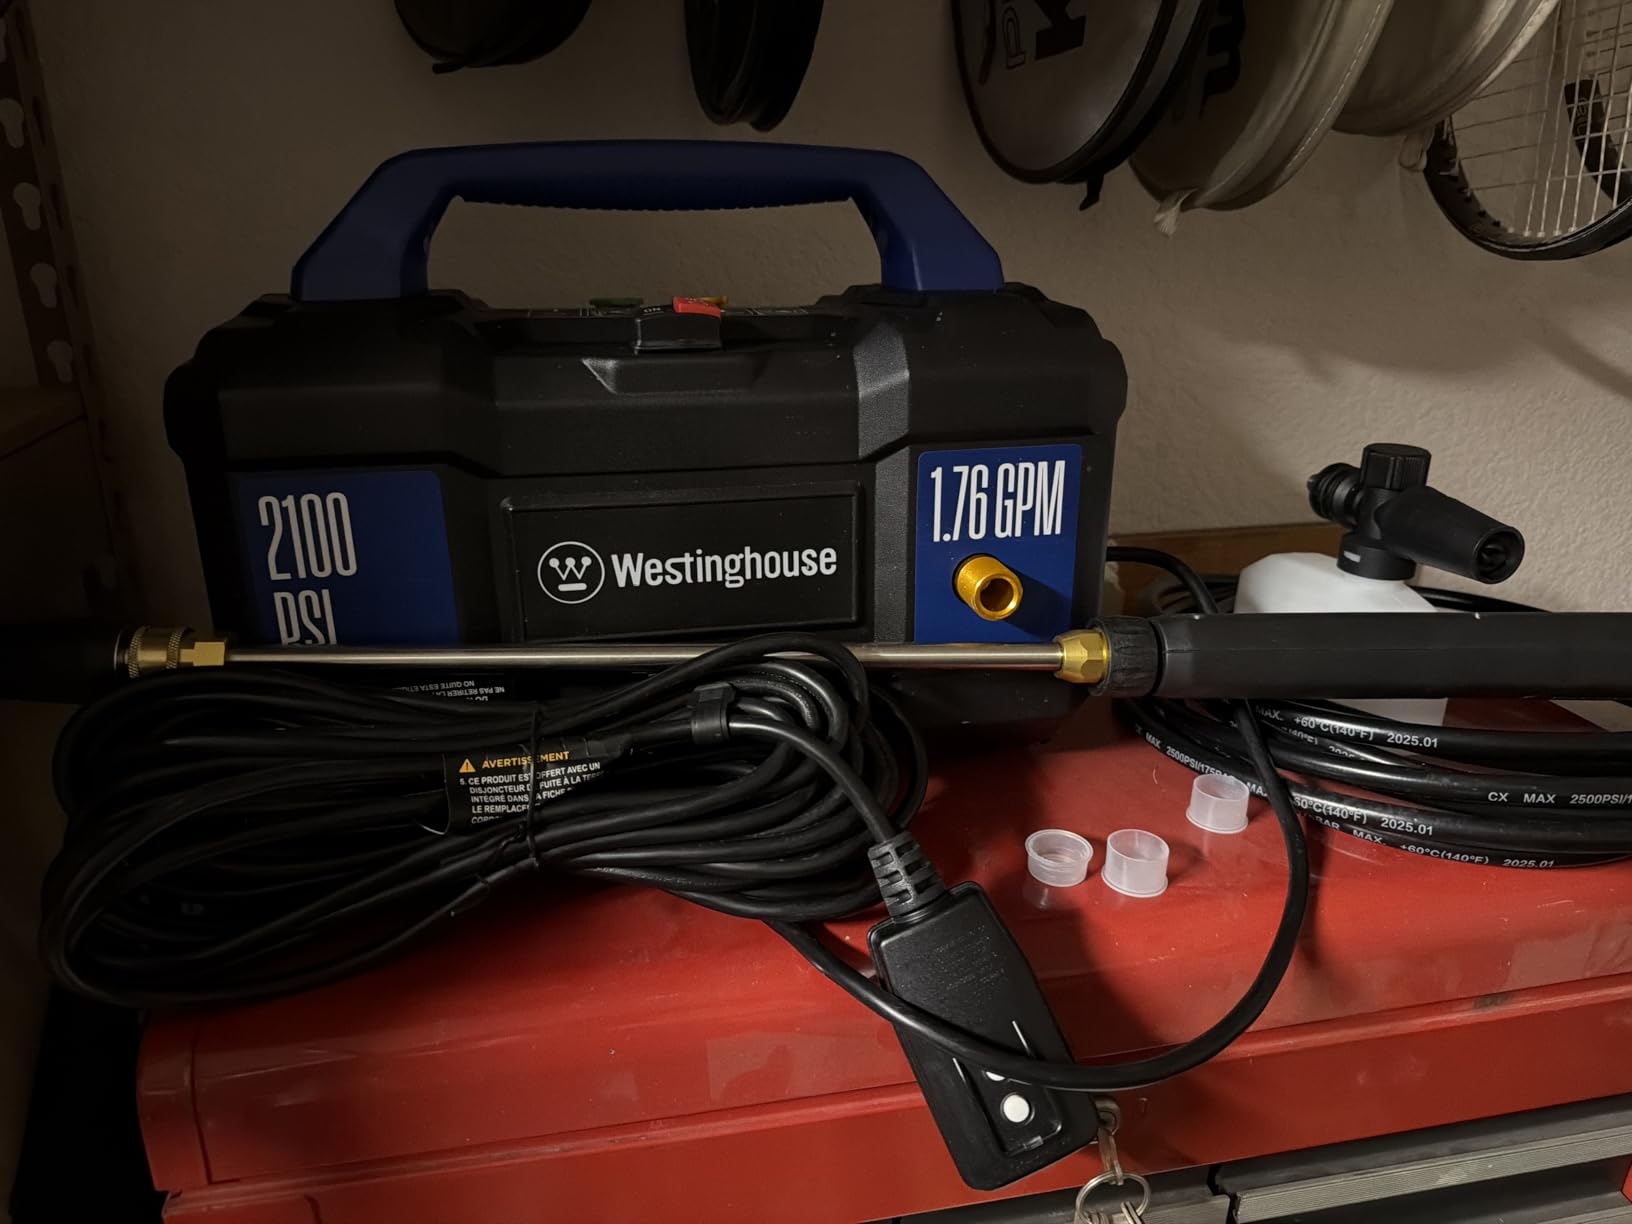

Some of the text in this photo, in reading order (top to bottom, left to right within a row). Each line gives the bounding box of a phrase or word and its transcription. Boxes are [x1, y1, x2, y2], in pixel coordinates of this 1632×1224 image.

[930, 460, 1066, 543] 1.76 GPM
[258, 492, 358, 581] 2100
[610, 546, 838, 589] Westinghouse
[273, 588, 338, 646] PSI
[1386, 731, 1439, 748] 2025.01
[482, 751, 570, 769] AVERTISSMENT
[468, 777, 480, 786] CE
[481, 774, 517, 785] PRODUIT
[567, 763, 588, 774] AVEC
[589, 761, 601, 771] UN
[469, 784, 526, 794] DISJONCTEUR
[539, 778, 562, 789] FUITE
[570, 775, 582, 785] LA
[471, 805, 483, 814] LE
[507, 793, 529, 803] DANS
[1247, 781, 1268, 797] MA
[1380, 817, 1434, 836] 2025.01
[1487, 792, 1632, 805] CX MAX 2500PSI/1
[1352, 829, 1387, 845] MAX.
[1503, 858, 1555, 869] 2025.01
